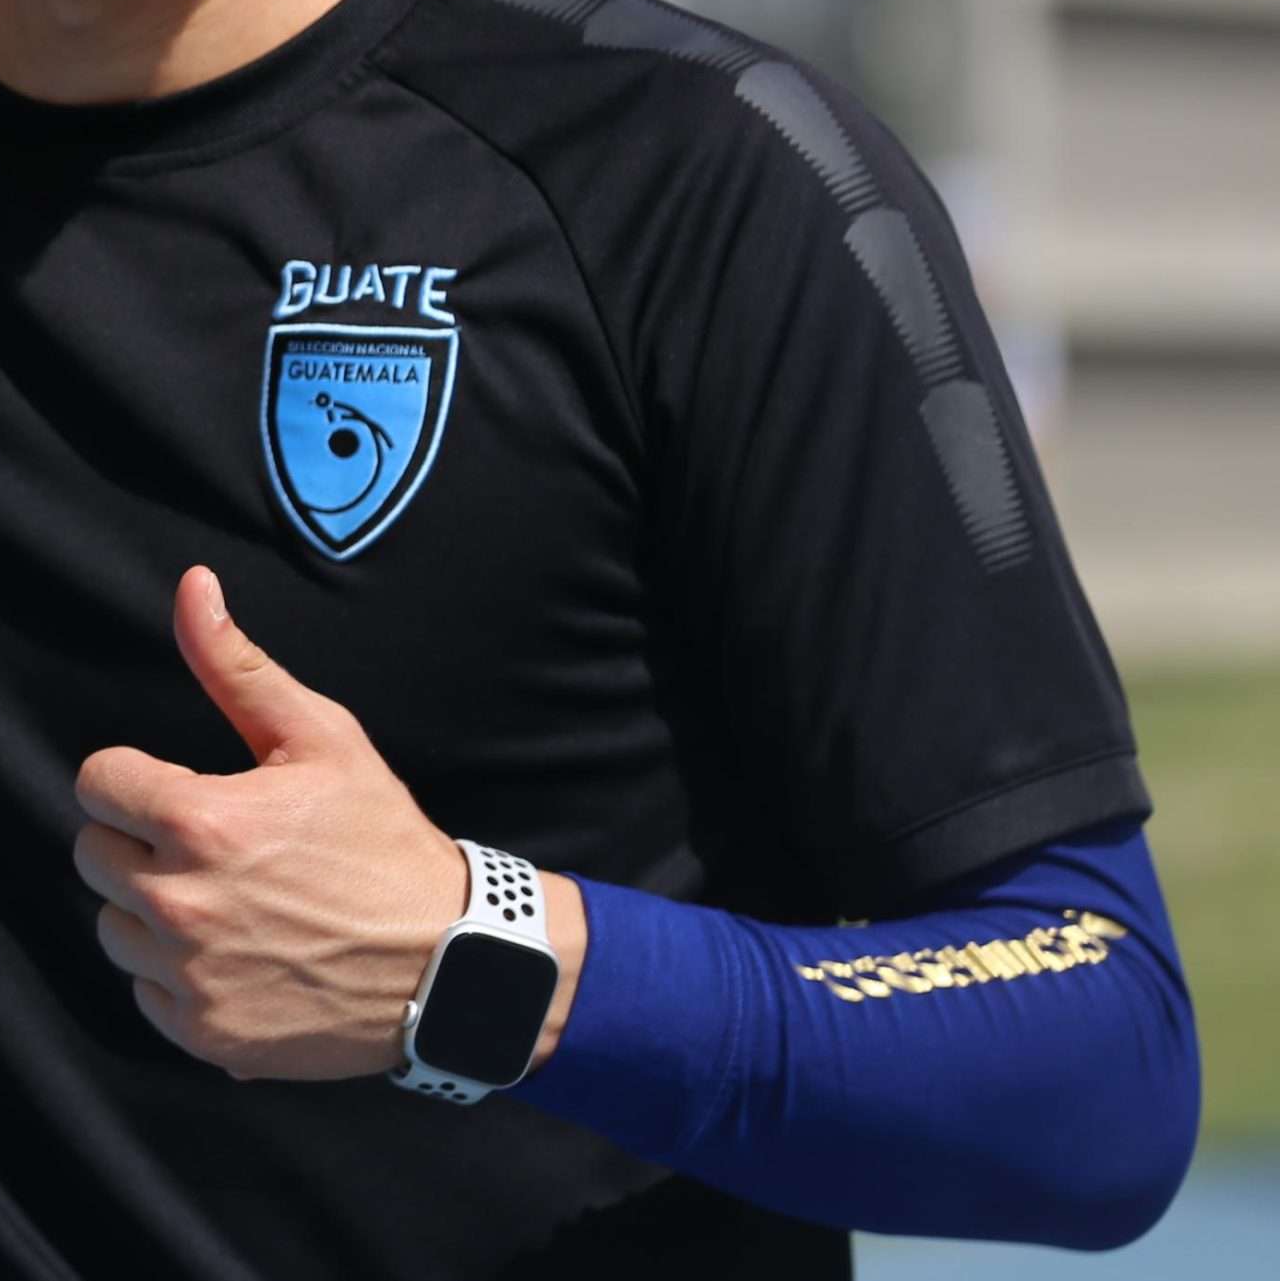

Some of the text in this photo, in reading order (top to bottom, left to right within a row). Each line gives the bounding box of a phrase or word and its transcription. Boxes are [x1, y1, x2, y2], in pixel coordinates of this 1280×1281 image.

[273, 259, 457, 325] GUATE
[355, 343, 427, 357] NACIONAL
[288, 360, 419, 384] GUATEMALA
